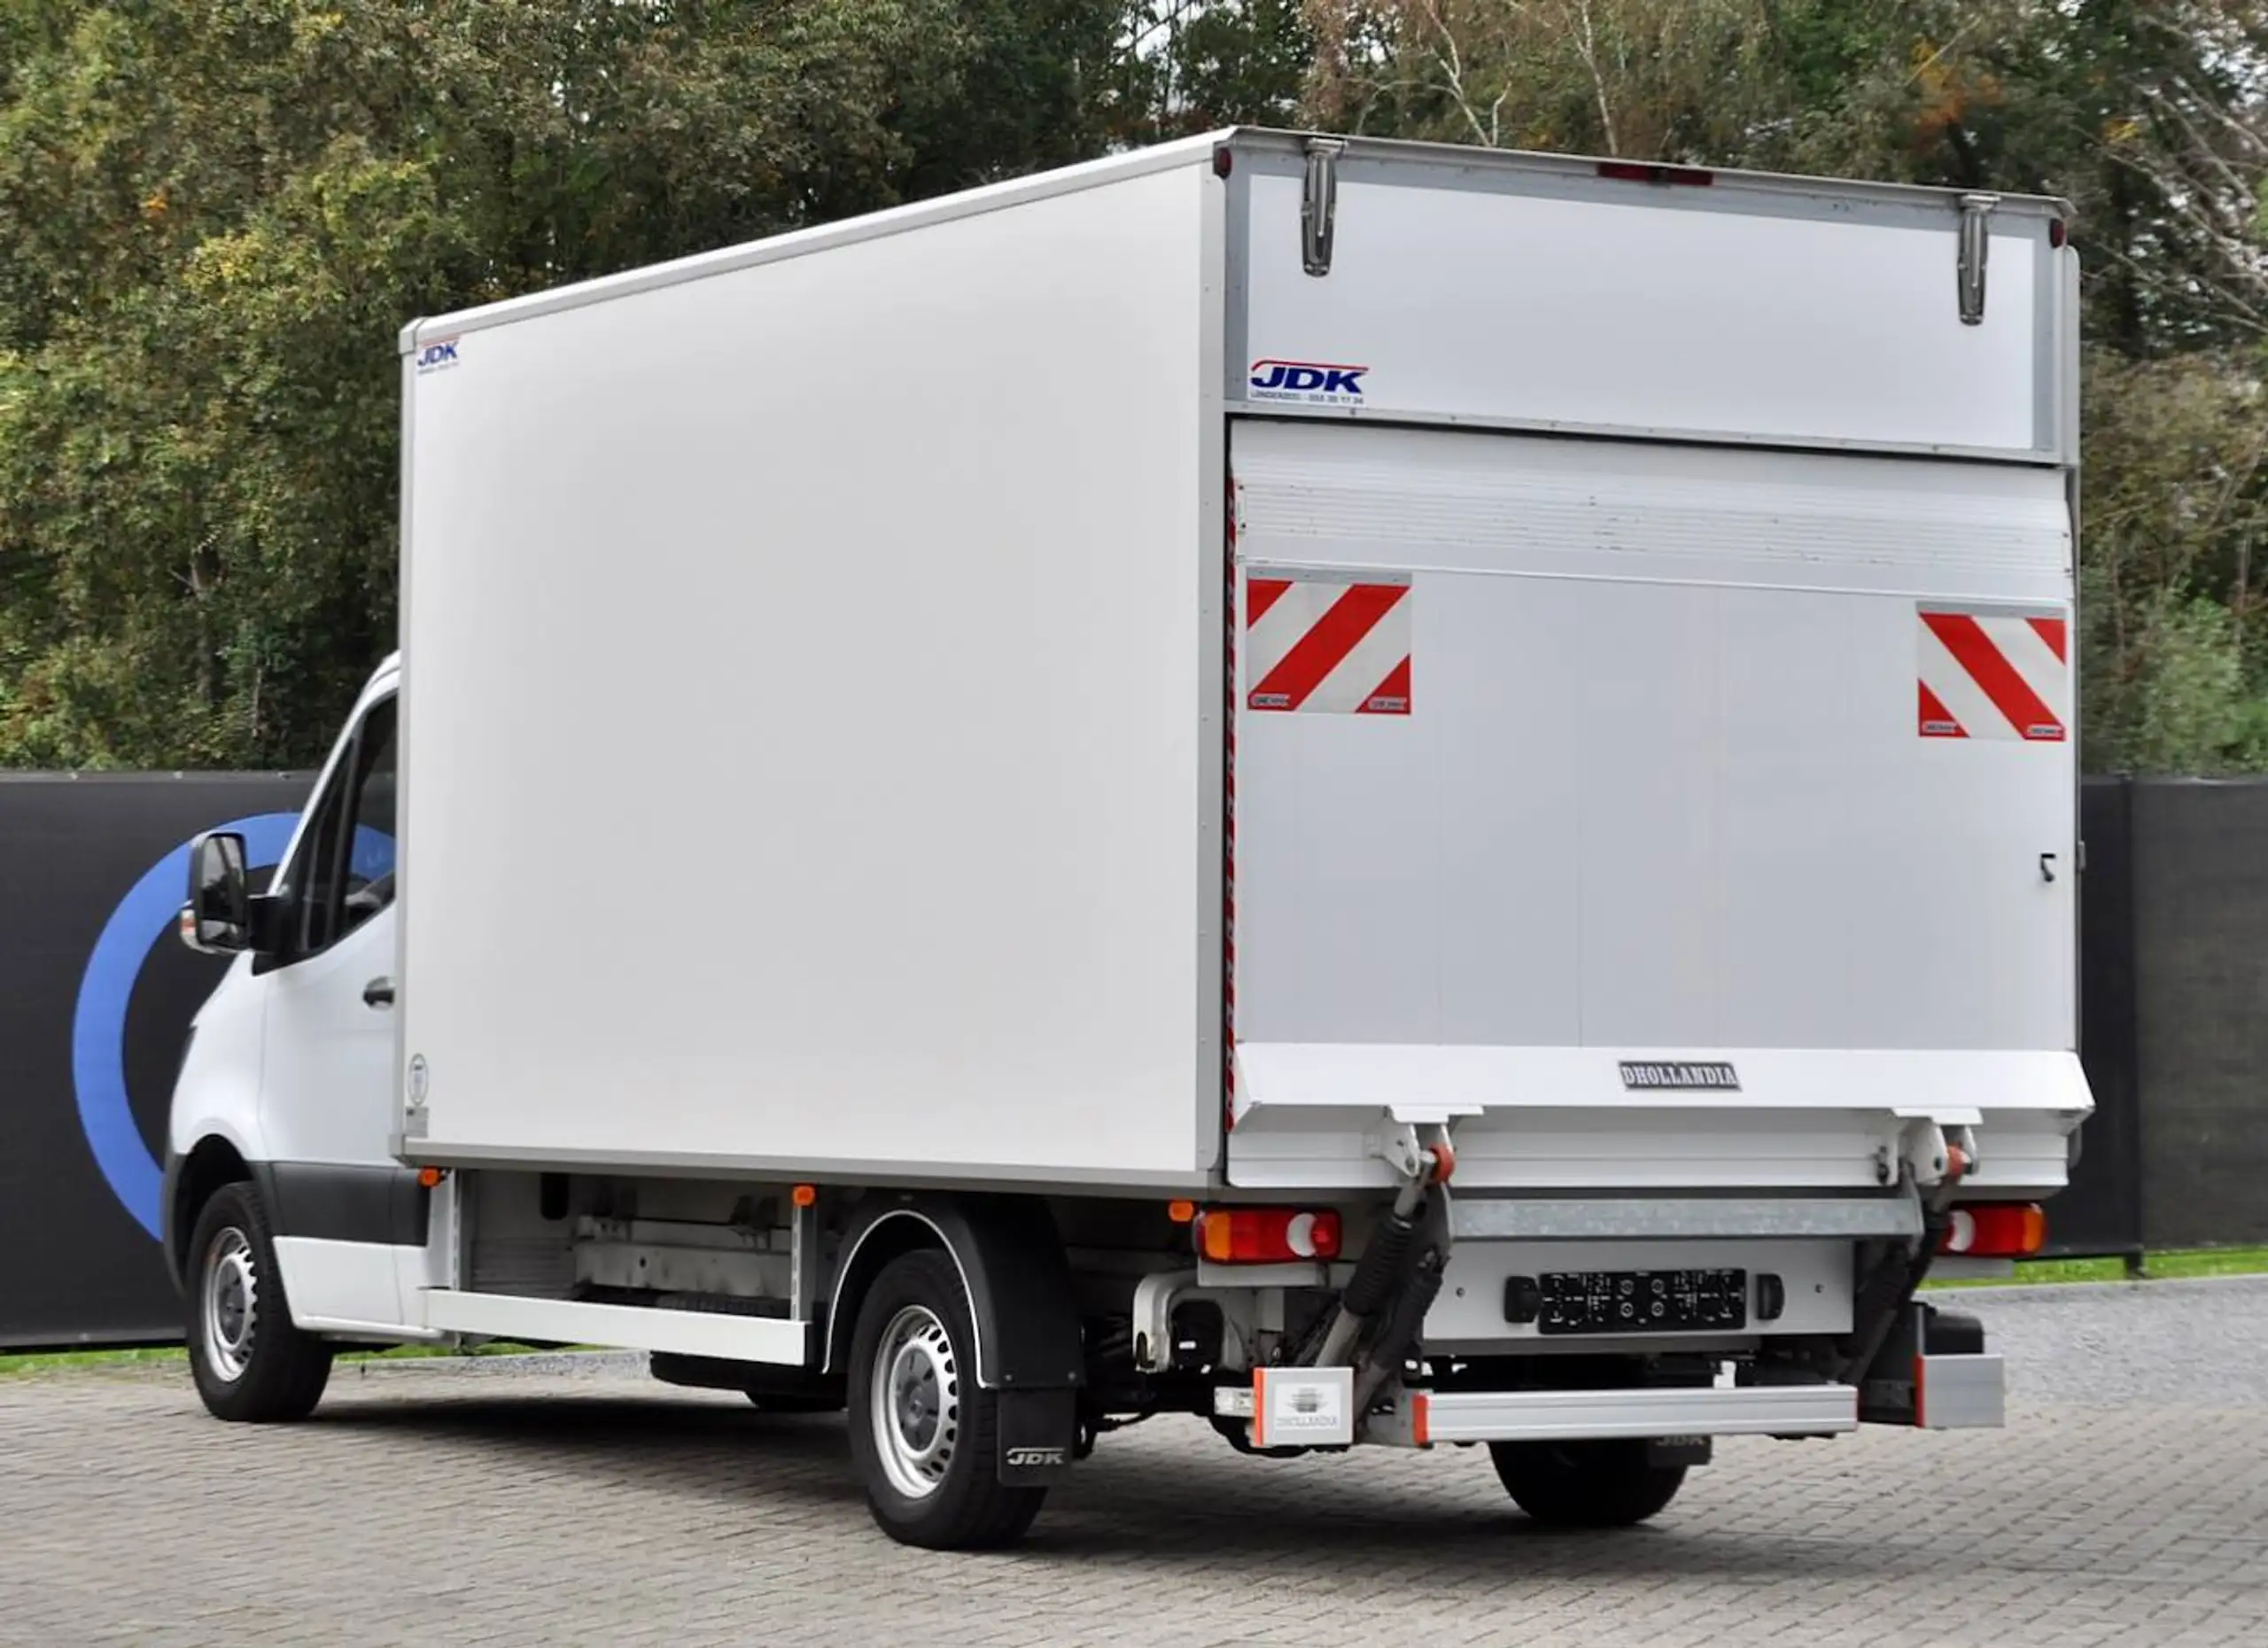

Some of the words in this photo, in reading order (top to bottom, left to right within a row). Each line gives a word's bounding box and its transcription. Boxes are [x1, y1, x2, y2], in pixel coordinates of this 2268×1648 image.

[417, 340, 459, 366] JDK
[1250, 366, 1366, 394] JDK
[1620, 1066, 1738, 1084] DHOLLANDIA
[1007, 1452, 1064, 1465] JDK
